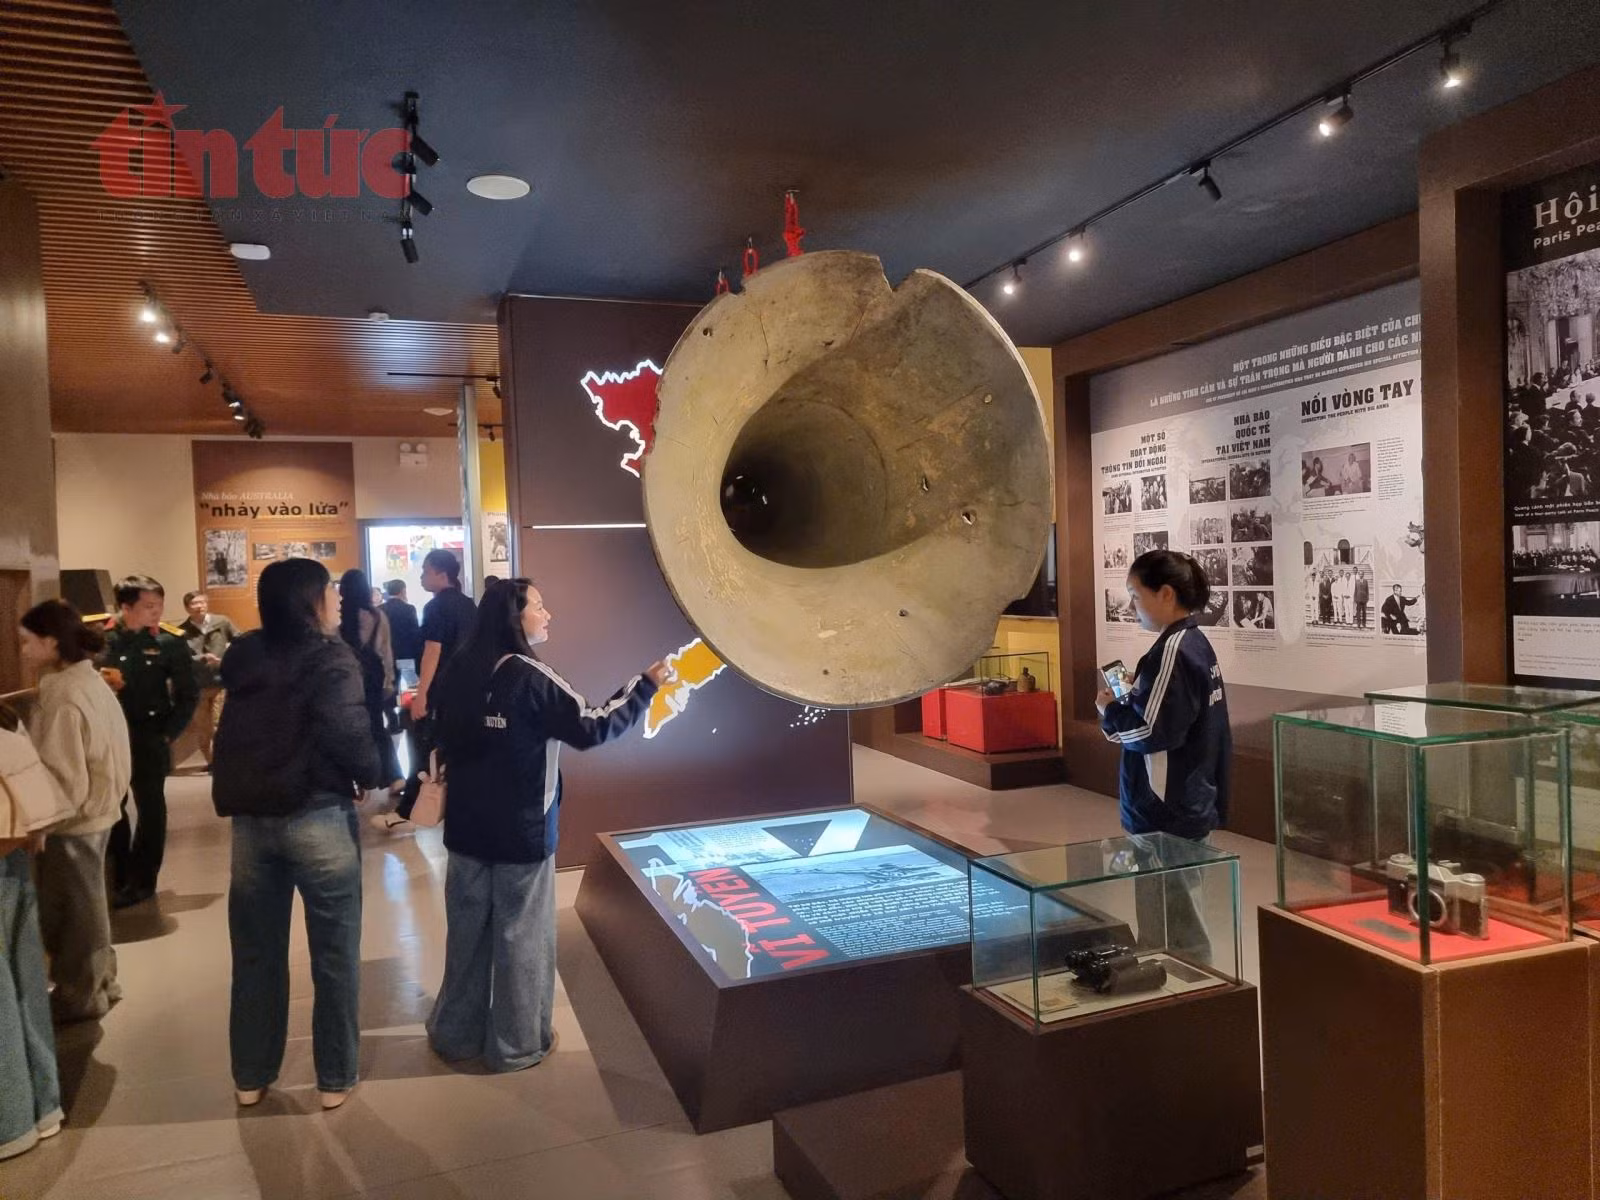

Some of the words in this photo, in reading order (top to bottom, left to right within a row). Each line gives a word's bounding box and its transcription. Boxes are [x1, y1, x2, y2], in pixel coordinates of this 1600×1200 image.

[1534, 185, 1599, 229] Hội
[1534, 230, 1571, 249] Paris
[1233, 359, 1250, 373] MỘT
[1251, 352, 1277, 367] TRONG
[1280, 345, 1308, 360] NHỮNG
[1334, 332, 1352, 346] ĐẶC
[1355, 325, 1378, 341] BIỆT
[1381, 317, 1402, 333] CỦA
[1405, 314, 1421, 328] CH
[1160, 391, 1181, 405] NHỮNG
[1217, 378, 1226, 390] VÀ
[1263, 364, 1290, 379] TRỌNG
[1292, 358, 1305, 372] MÀ
[1308, 351, 1334, 369] NGƯỜI
[1336, 345, 1362, 362] DÀNH
[1365, 341, 1385, 354] CHO
[1388, 333, 1408, 349] CÁC
[1411, 331, 1421, 344] N
[1301, 392, 1327, 417] NỐI
[1332, 388, 1374, 410] VÒNG
[1380, 379, 1414, 401] TAY
[1234, 412, 1250, 426] NHÀ
[1253, 408, 1270, 422] BÁO
[1236, 424, 1257, 439] QUỐC
[1259, 420, 1270, 434] TẾ
[1231, 440, 1250, 453] VIỆT
[1253, 437, 1271, 449] NAM
[1101, 463, 1121, 474] THÔNG
[1122, 461, 1133, 470] TIN
[201, 492, 220, 501] Nhà
[221, 491, 239, 501] báo
[239, 492, 294, 501] AUSTRALIA
[267, 501, 302, 516] vào
